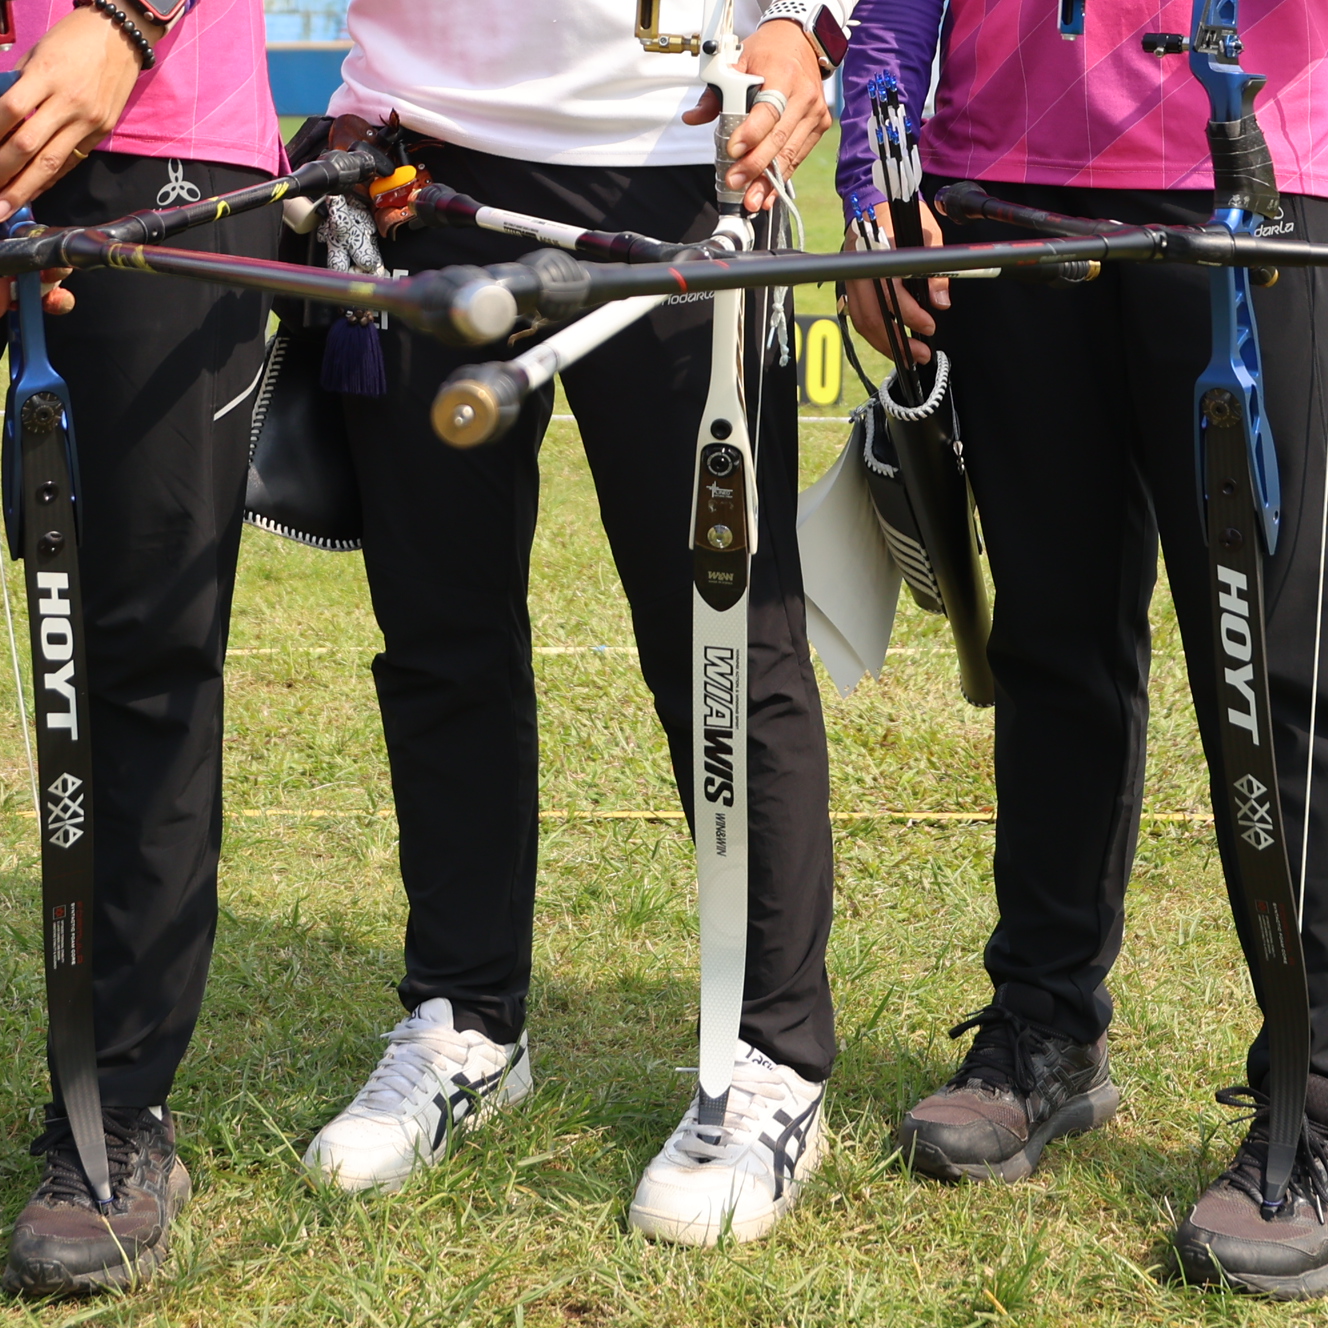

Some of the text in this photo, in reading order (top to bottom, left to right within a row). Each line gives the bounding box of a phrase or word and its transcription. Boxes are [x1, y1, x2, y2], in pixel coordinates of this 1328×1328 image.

[1253, 220, 1295, 238] darla
[795, 318, 842, 405] 0
[37, 571, 78, 741] HOYT
[1217, 564, 1260, 746] HOYT
[703, 647, 735, 808] WIAWIS
[715, 812, 727, 857] WIN&WIN
